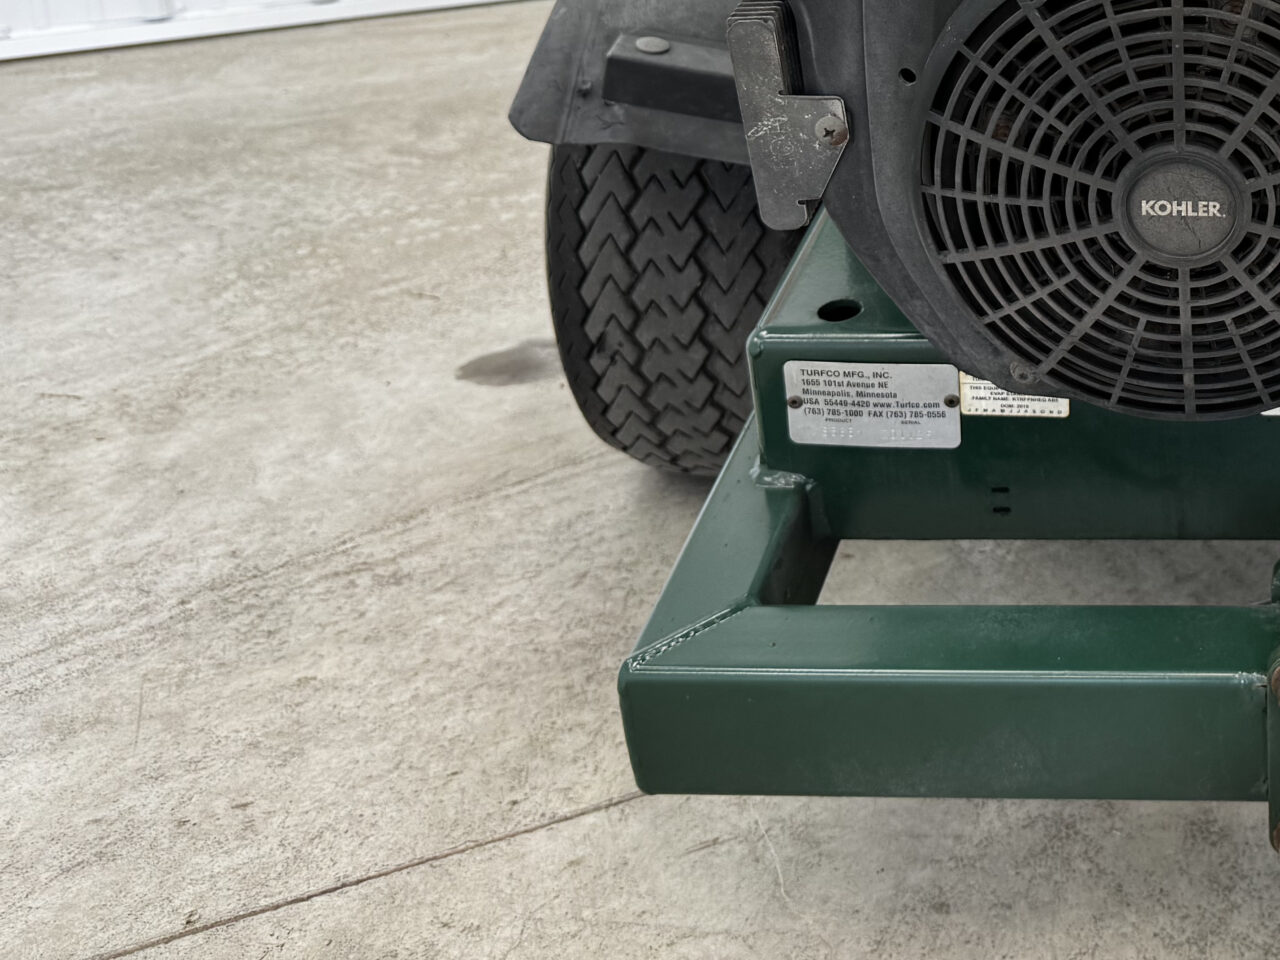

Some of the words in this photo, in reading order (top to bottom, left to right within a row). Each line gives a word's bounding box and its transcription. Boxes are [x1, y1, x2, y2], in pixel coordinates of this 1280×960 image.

[1141, 200, 1221, 218] KOHLER
[800, 369, 840, 378] TURFCO
[872, 371, 892, 379] INC.
[802, 388, 853, 398] Minneapolis,
[855, 390, 898, 399] Minnesota
[803, 397, 820, 405] USA
[804, 407, 824, 416] (763)
[886, 410, 907, 419] (763)
